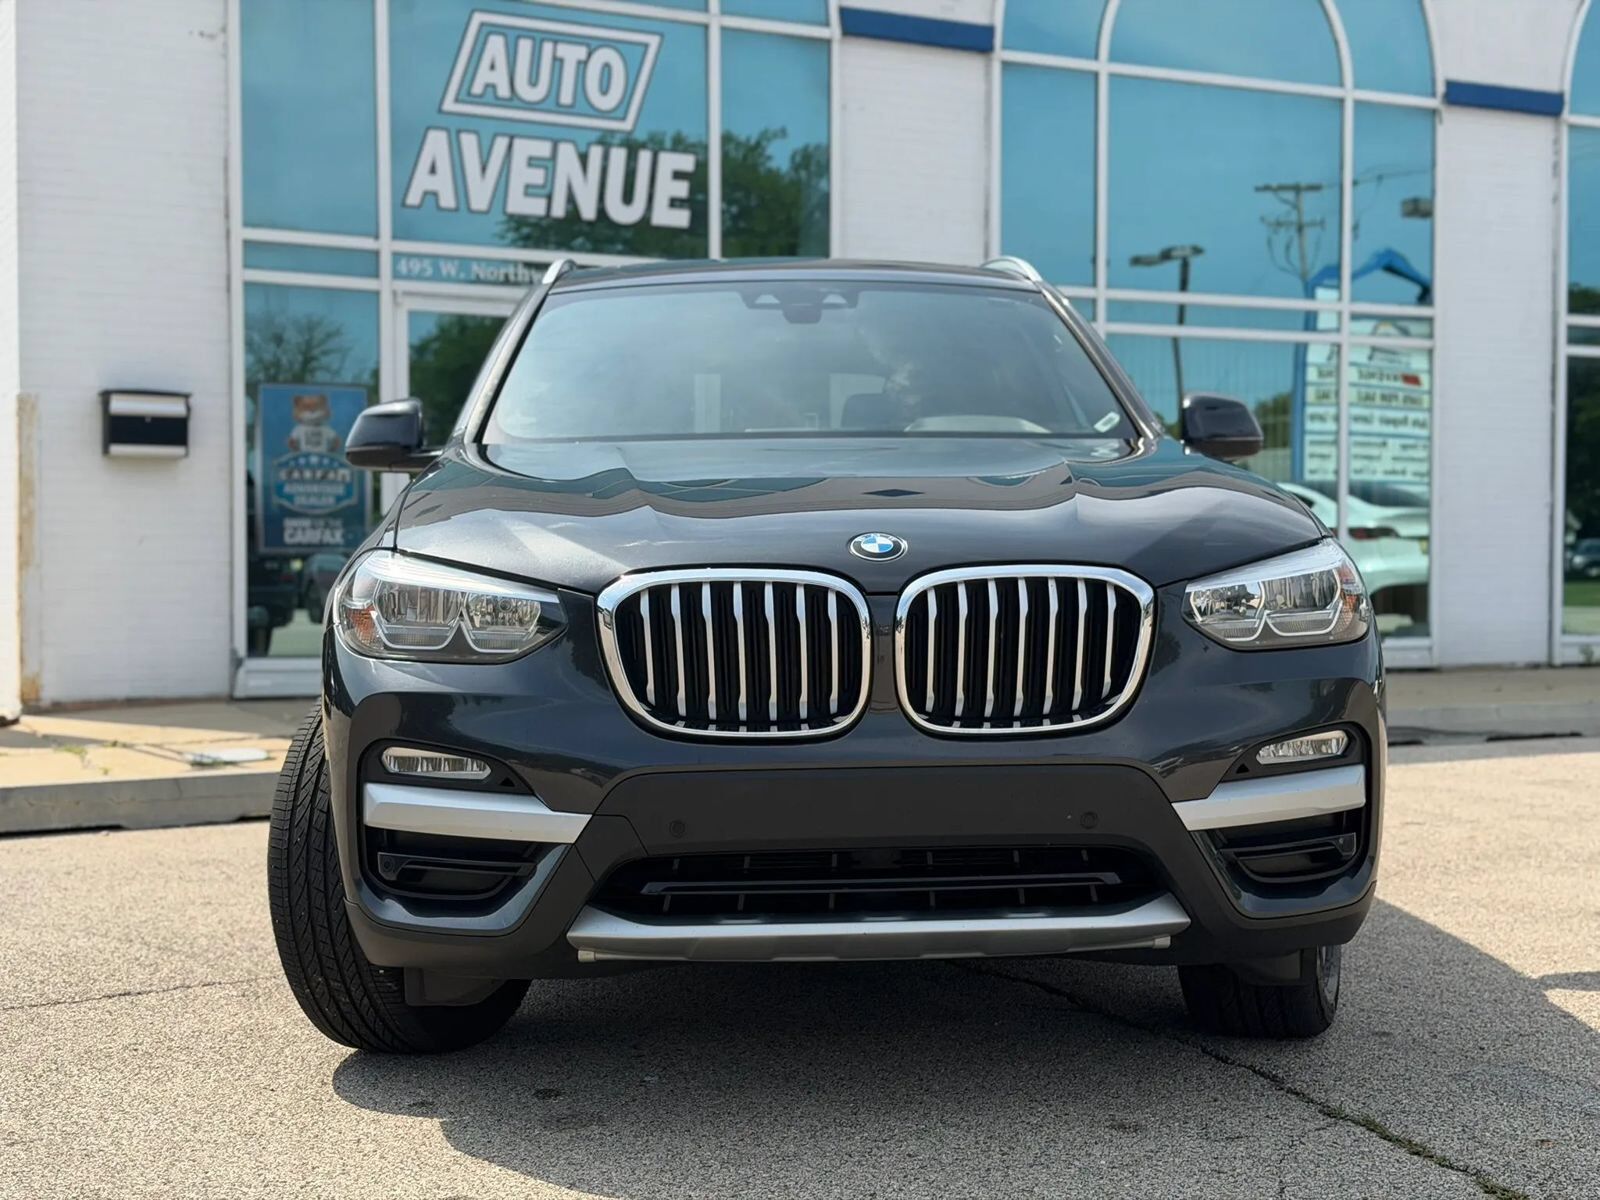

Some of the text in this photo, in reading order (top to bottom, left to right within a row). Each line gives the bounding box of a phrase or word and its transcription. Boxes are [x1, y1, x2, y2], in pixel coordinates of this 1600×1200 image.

[469, 33, 628, 112] AUTO
[404, 127, 696, 229] AVENUE
[396, 257, 433, 277] 495
[439, 260, 465, 279] W.
